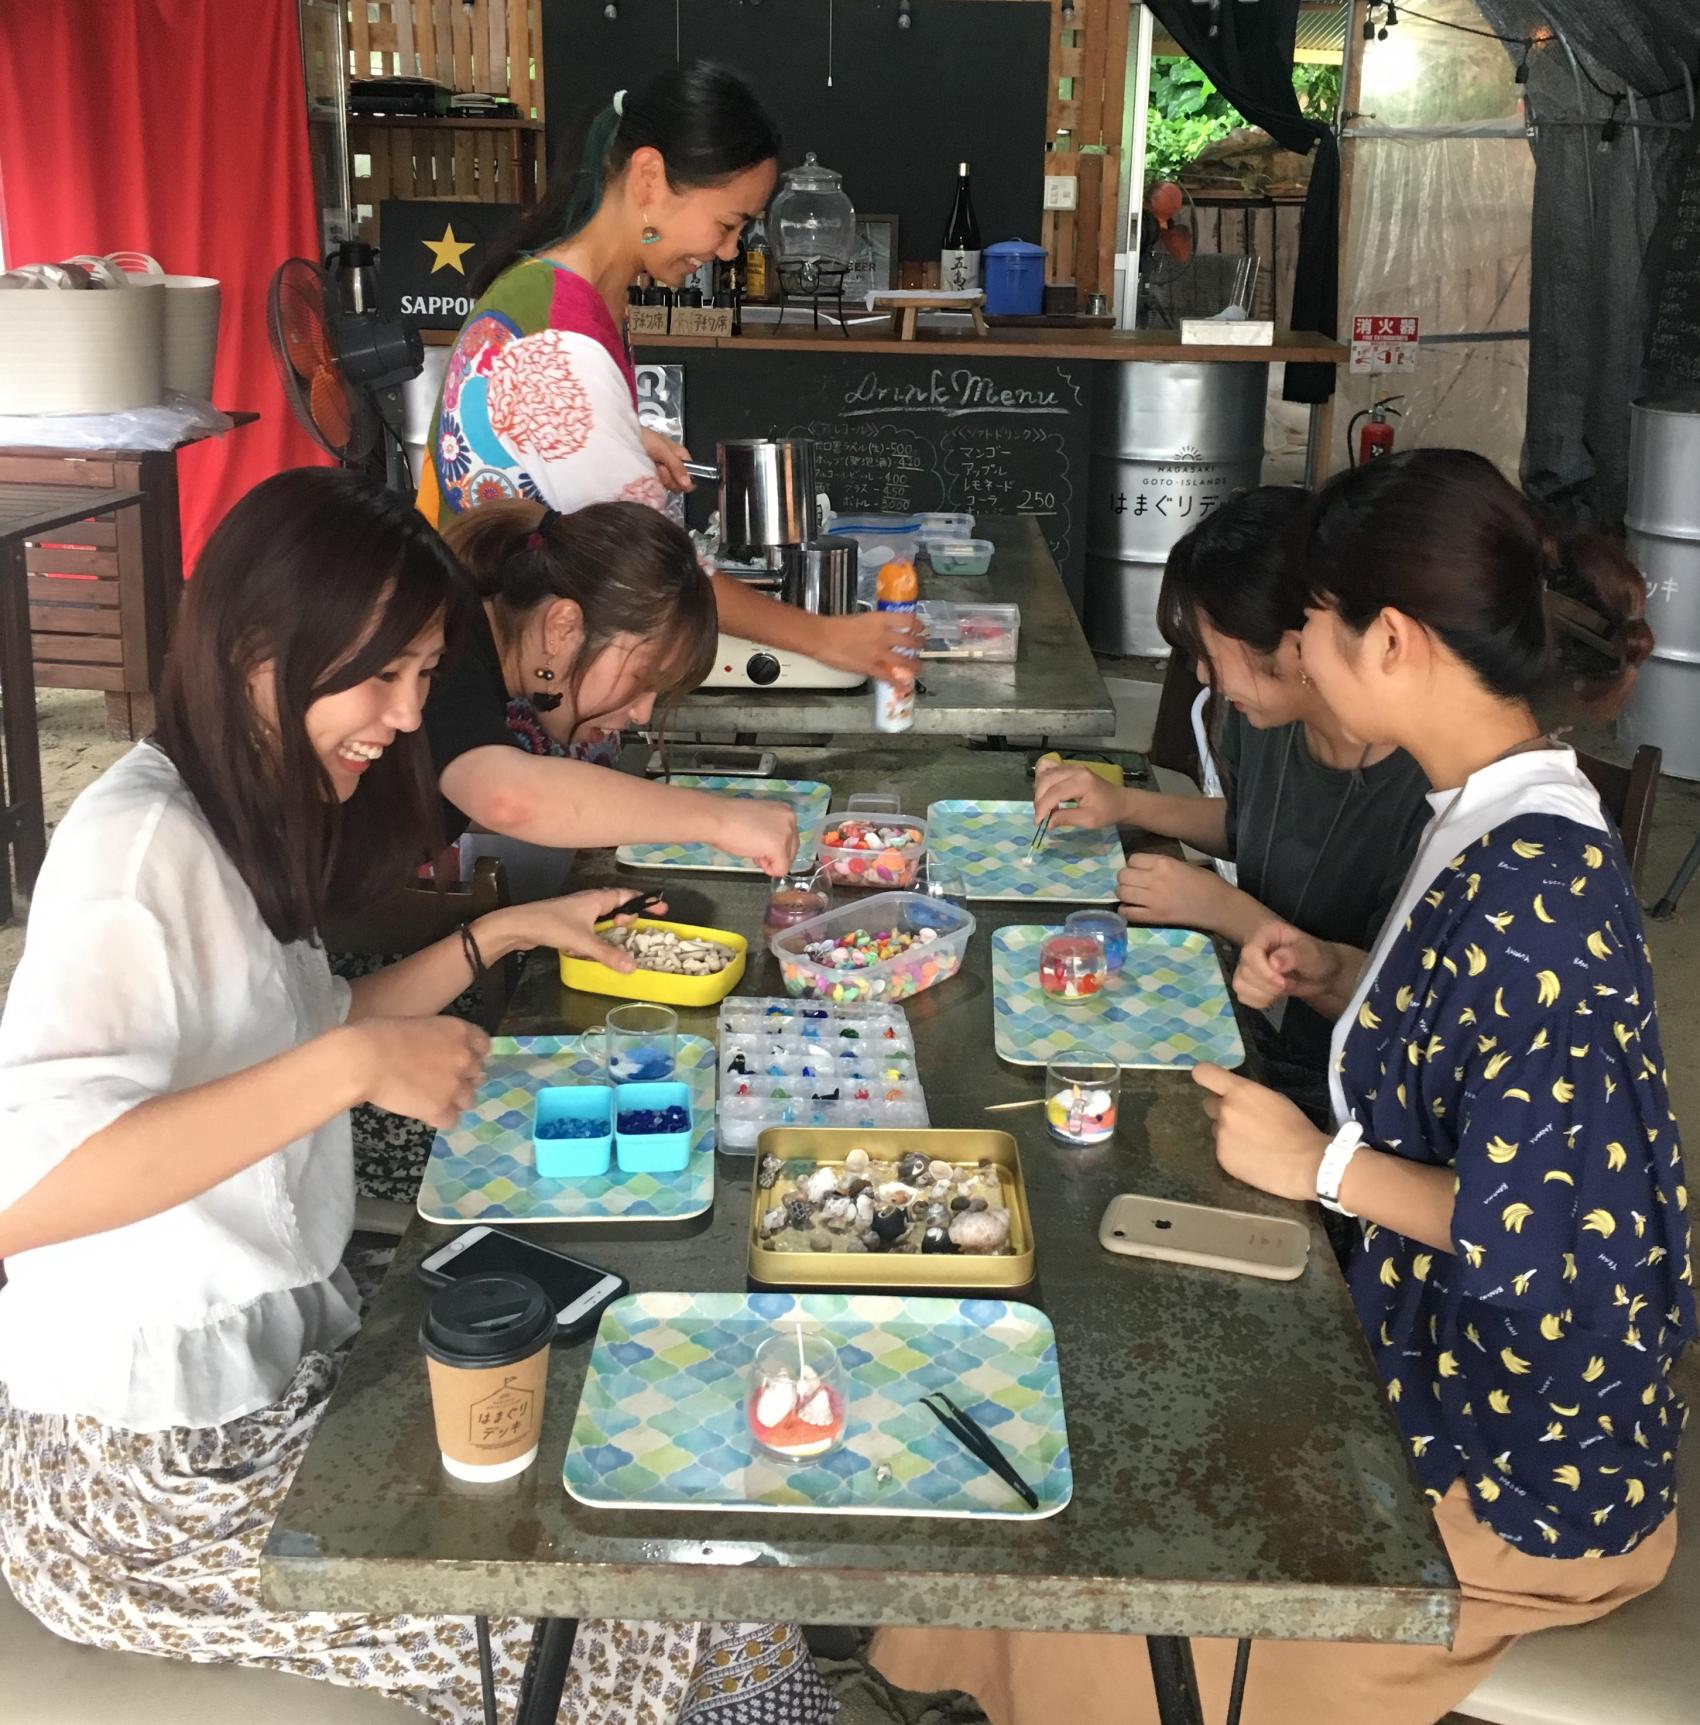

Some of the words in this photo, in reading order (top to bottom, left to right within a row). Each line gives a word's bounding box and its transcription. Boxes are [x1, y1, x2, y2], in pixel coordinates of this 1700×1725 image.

[1355, 318, 1416, 335] 消火器
[845, 369, 950, 405] Drink
[951, 370, 1061, 405] Menu
[959, 445, 1012, 458] マンゴー
[960, 462, 1008, 476] アップル
[1157, 465, 1216, 473] NAGASAKI
[963, 478, 1016, 493] レモネード
[965, 494, 998, 506] コーラ
[1016, 489, 1056, 509] 250
[482, 1420, 521, 1441] デッキ
